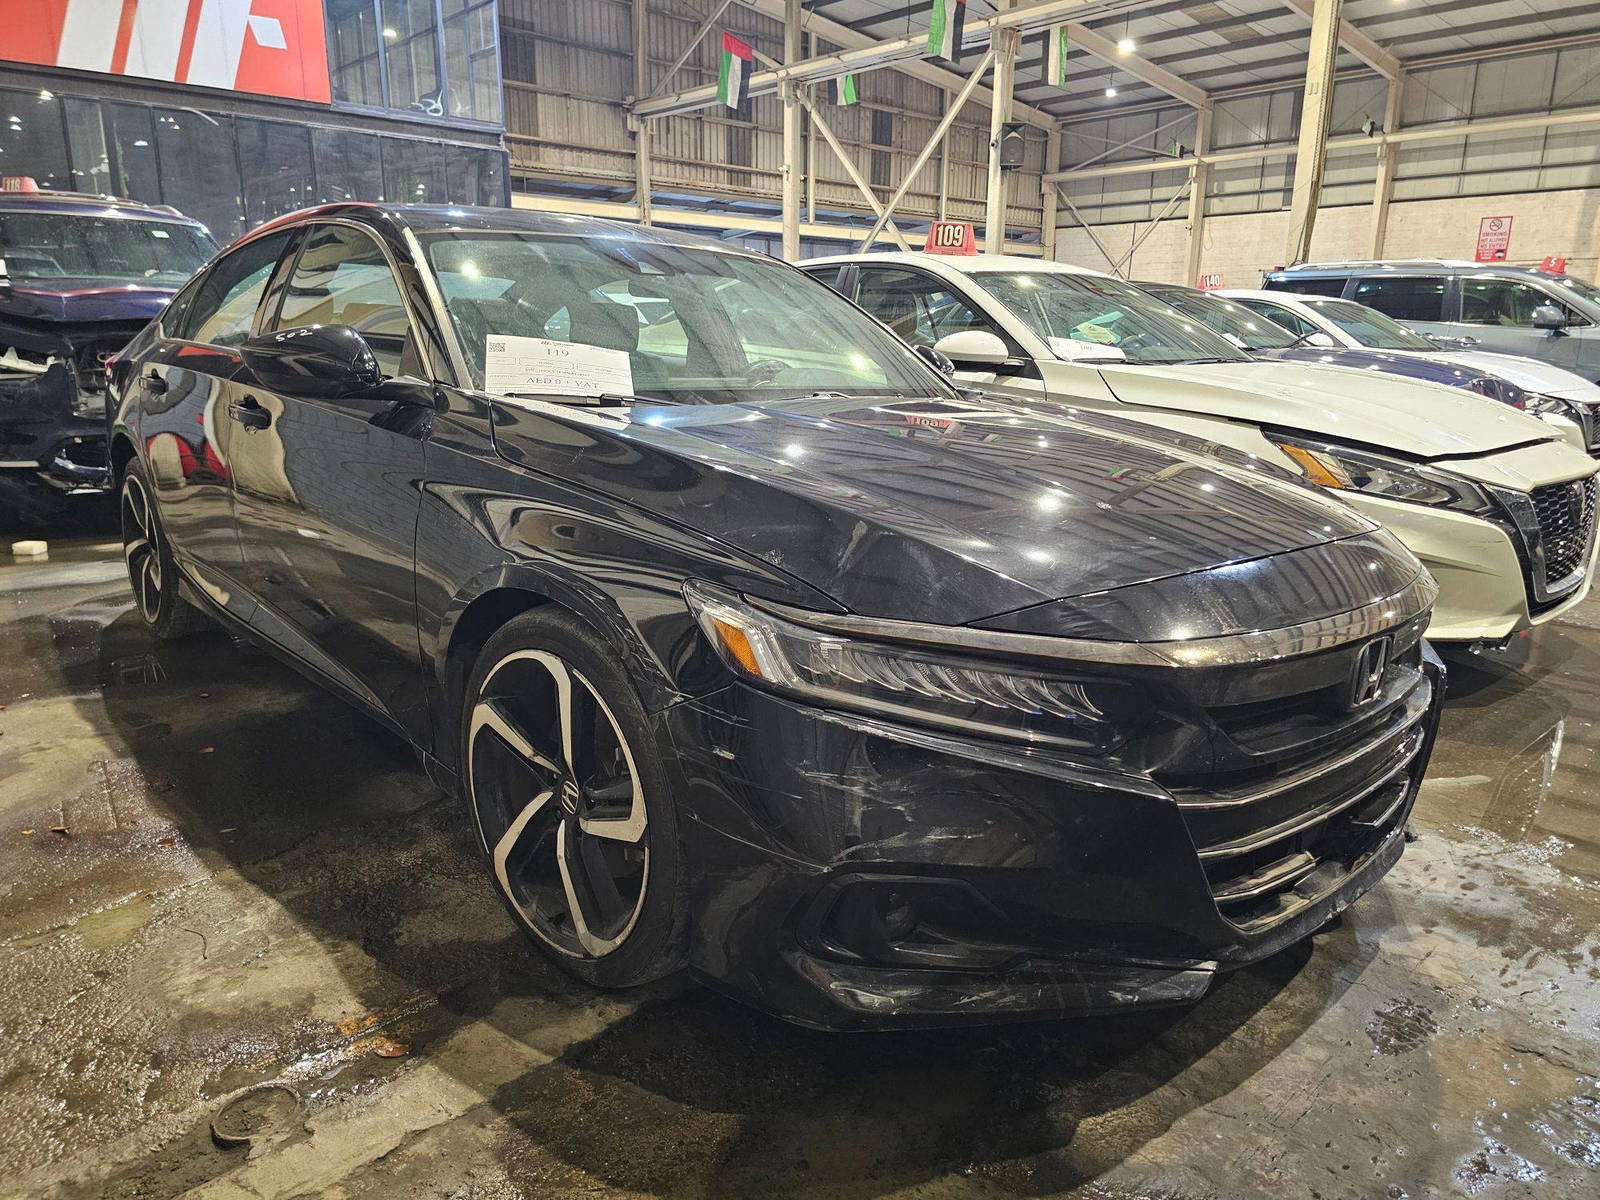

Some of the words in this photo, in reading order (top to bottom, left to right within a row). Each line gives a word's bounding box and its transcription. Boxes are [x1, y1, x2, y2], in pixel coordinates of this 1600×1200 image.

[937, 224, 963, 247] 109
[1204, 274, 1220, 287] 140
[546, 347, 570, 357] 119
[526, 377, 552, 385] AED
[575, 381, 600, 389] VAT
